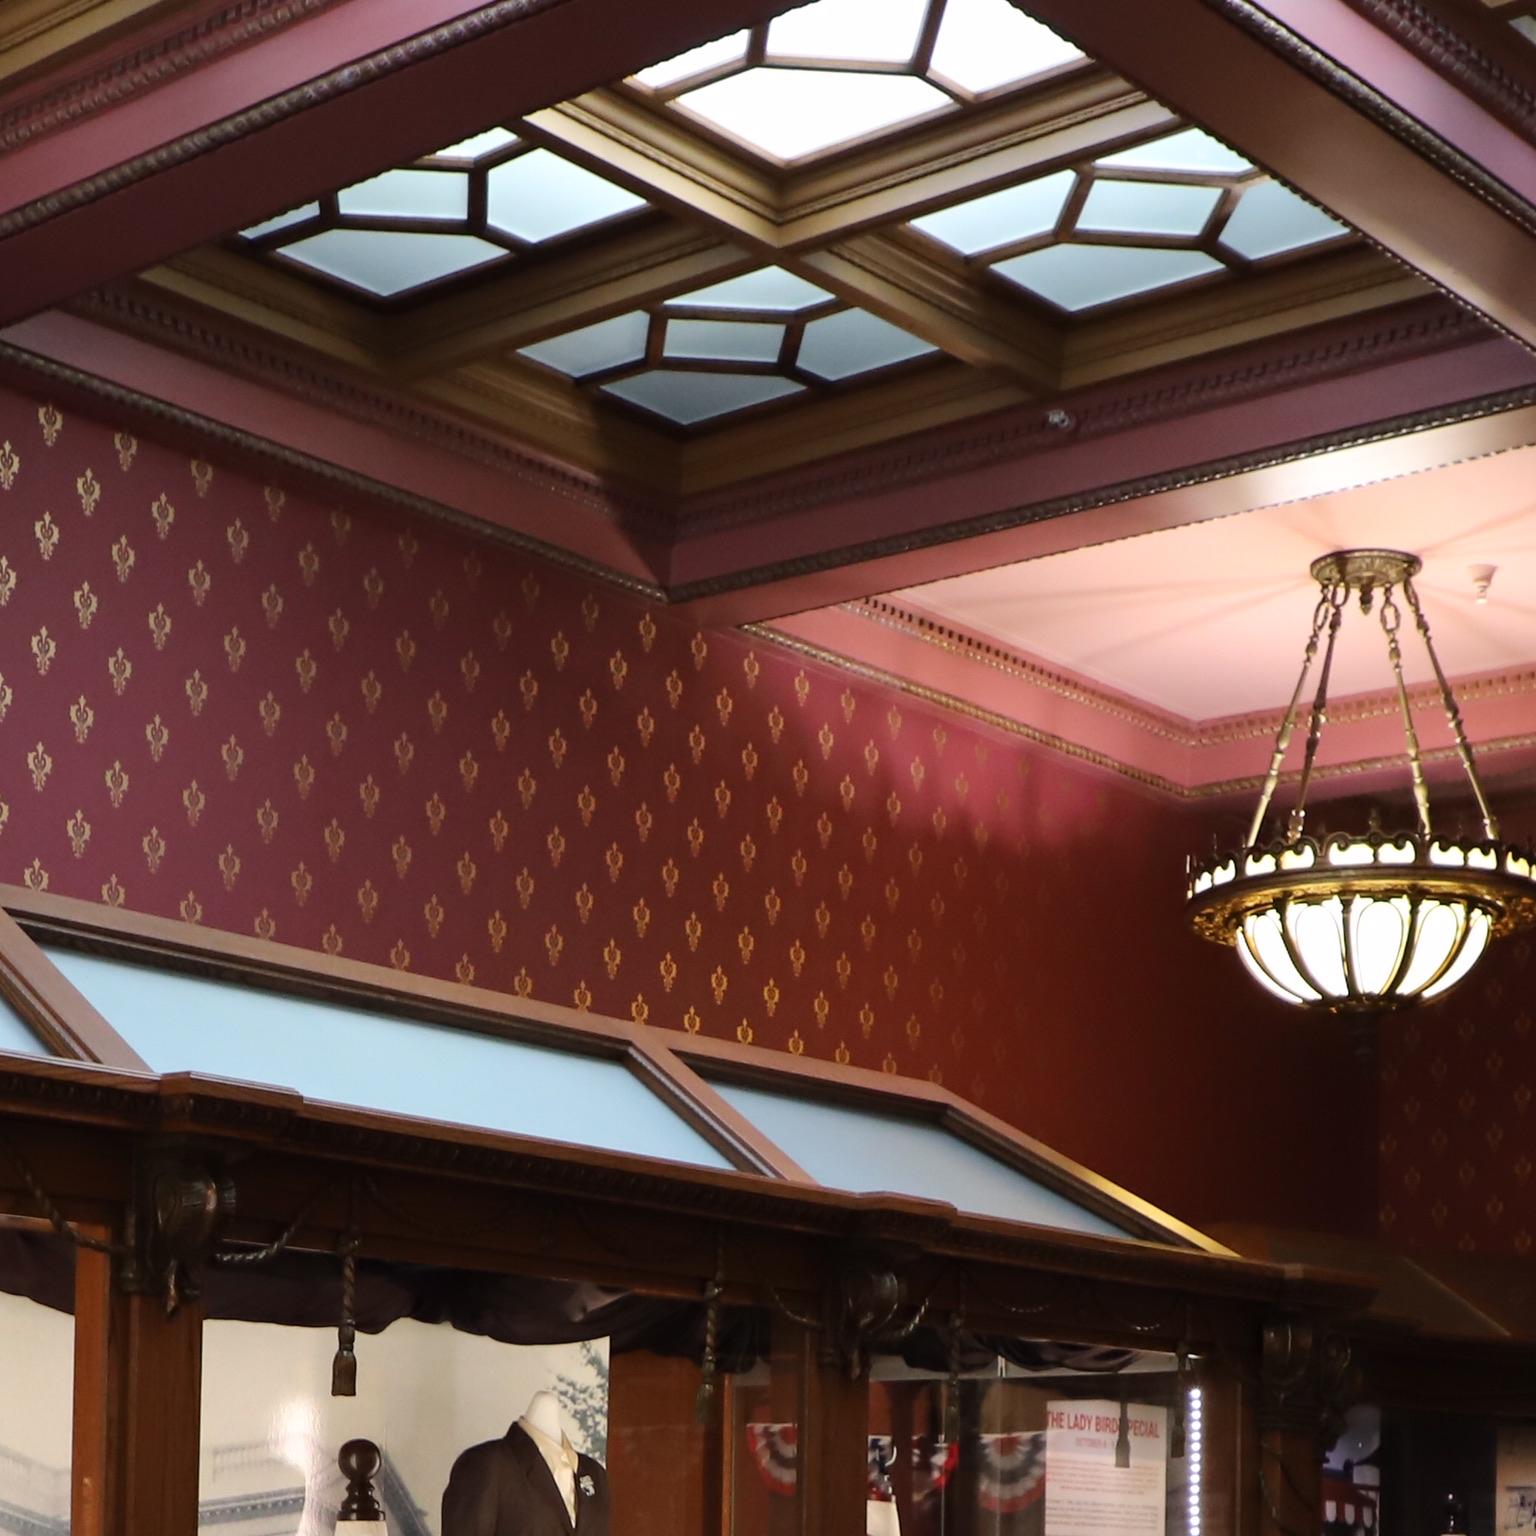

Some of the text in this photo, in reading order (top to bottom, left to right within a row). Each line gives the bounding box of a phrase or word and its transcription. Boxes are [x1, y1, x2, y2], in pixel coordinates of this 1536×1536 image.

[1048, 1411, 1160, 1438] THE LADY BIRD PECIAL
